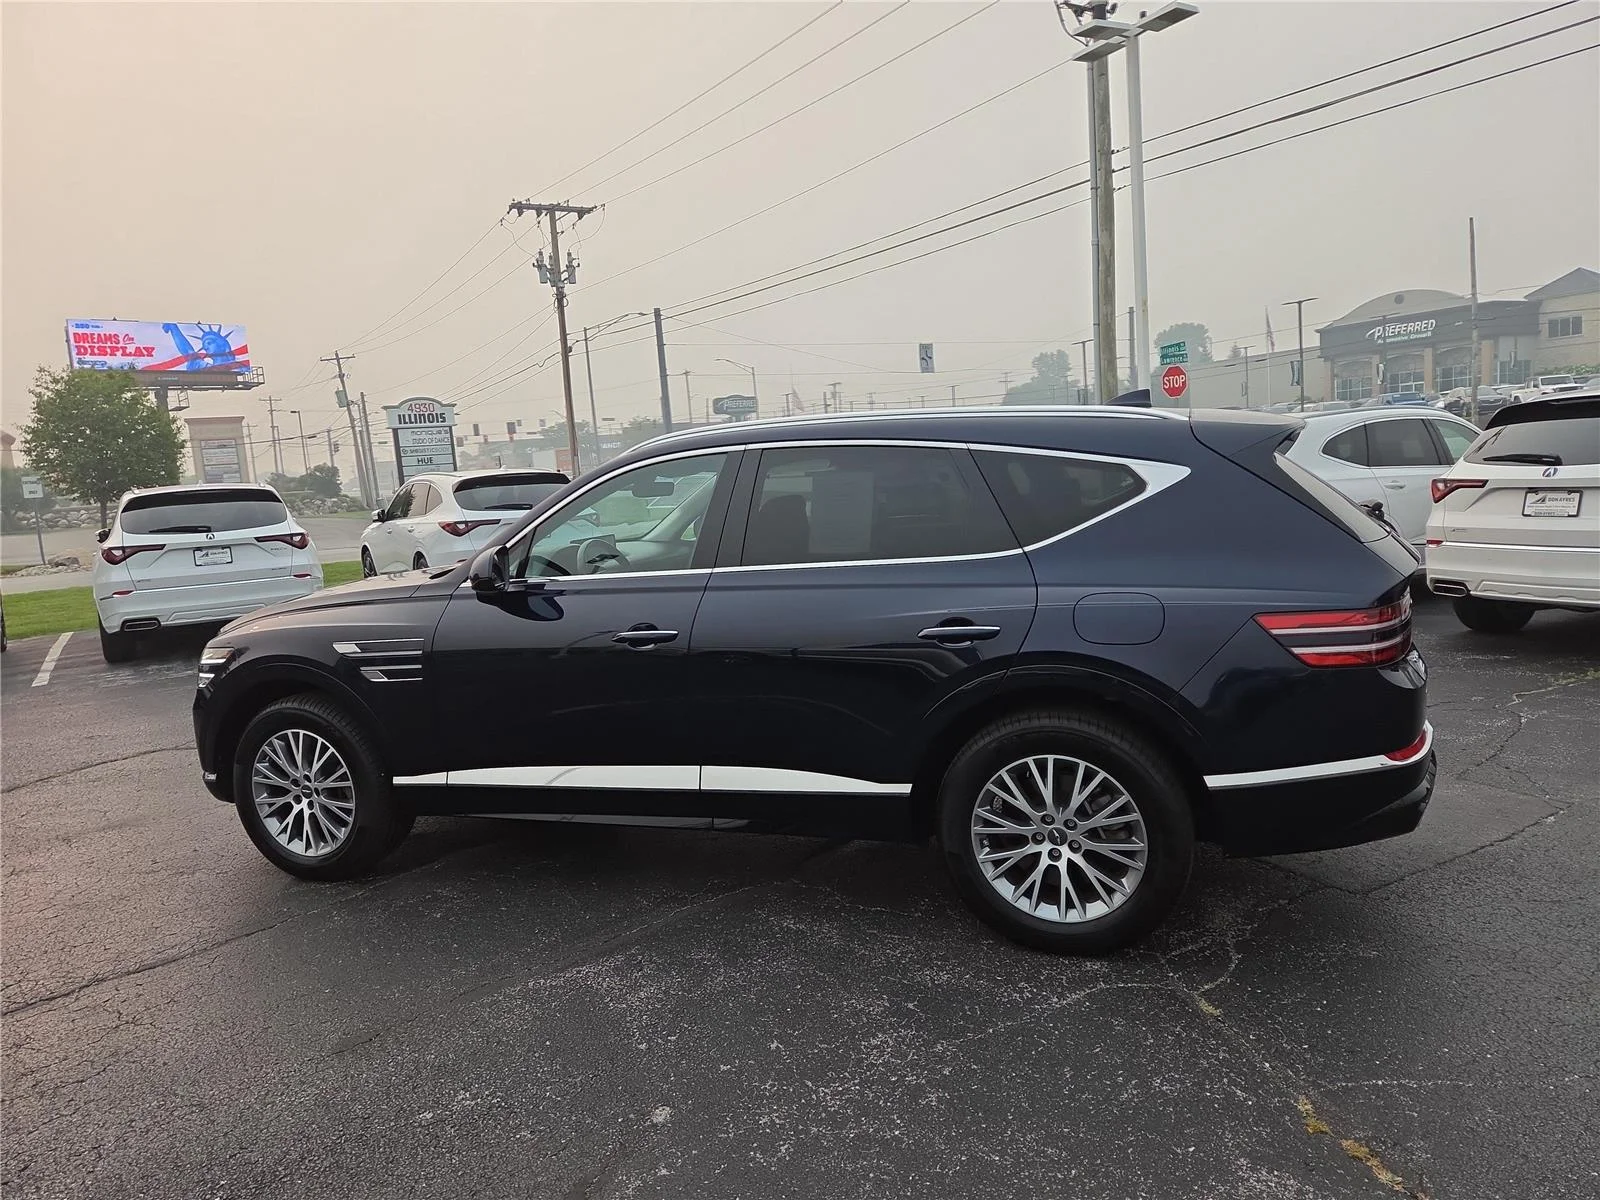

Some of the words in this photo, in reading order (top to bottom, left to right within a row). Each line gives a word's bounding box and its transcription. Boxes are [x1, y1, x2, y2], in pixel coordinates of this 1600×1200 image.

[73, 332, 120, 344] DREAMS
[75, 345, 155, 358] DISPLAY
[1163, 375, 1186, 389] STOP
[407, 402, 436, 413] 4930
[397, 412, 447, 425] ILLINOIS
[416, 456, 434, 464] HUE
